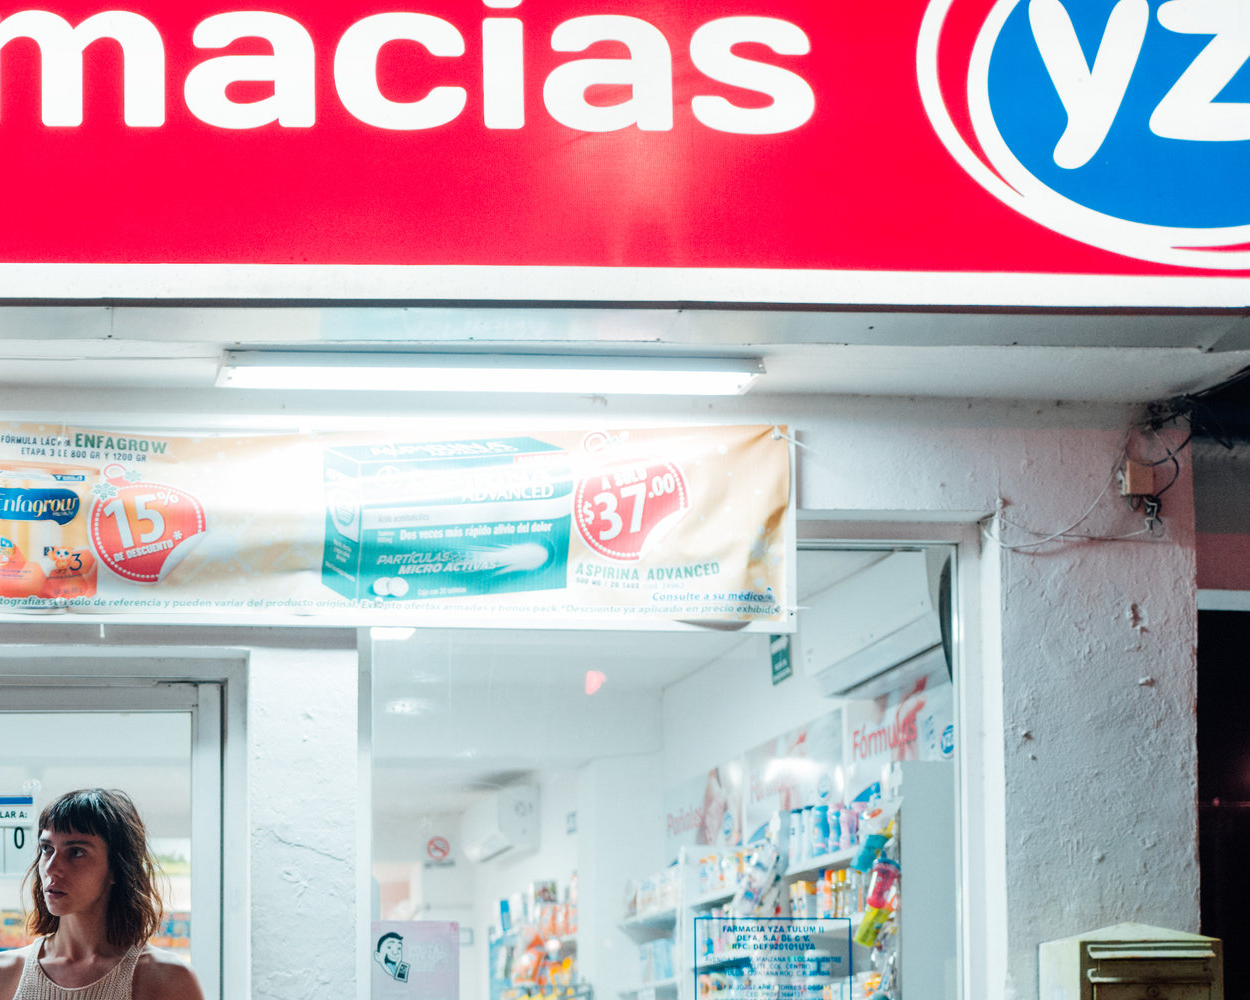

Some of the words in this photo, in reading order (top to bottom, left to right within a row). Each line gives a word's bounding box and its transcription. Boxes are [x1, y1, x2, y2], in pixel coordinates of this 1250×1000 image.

[75, 433, 167, 454] ENFAGROW
[21, 447, 46, 456] ETAPA
[50, 449, 55, 457] 3
[70, 450, 86, 459] 800
[90, 451, 100, 460] GR
[104, 452, 109, 460] Y
[113, 452, 132, 461] 1200
[136, 453, 147, 462] GR
[462, 483, 555, 502] ADVANCED
[583, 473, 675, 541] $37.00
[400, 529, 417, 540] Dos
[419, 530, 443, 540] veces
[446, 526, 463, 538] más
[465, 524, 492, 539] rápido
[493, 523, 515, 535] alivio
[517, 522, 529, 534] del
[531, 521, 552, 533] dolor
[113, 552, 125, 562] DE
[377, 550, 449, 564] PARTÍCULAS
[398, 563, 442, 575] MICRO
[443, 561, 497, 572] ACTIVAS
[575, 562, 640, 580] ASPIRINA
[646, 561, 720, 580] ADVANCED
[109, 598, 161, 607] referencia
[172, 598, 212, 609] pueden
[214, 599, 244, 608] variar
[246, 598, 263, 608] del
[266, 599, 314, 609] producto
[652, 592, 699, 601] Consulte
